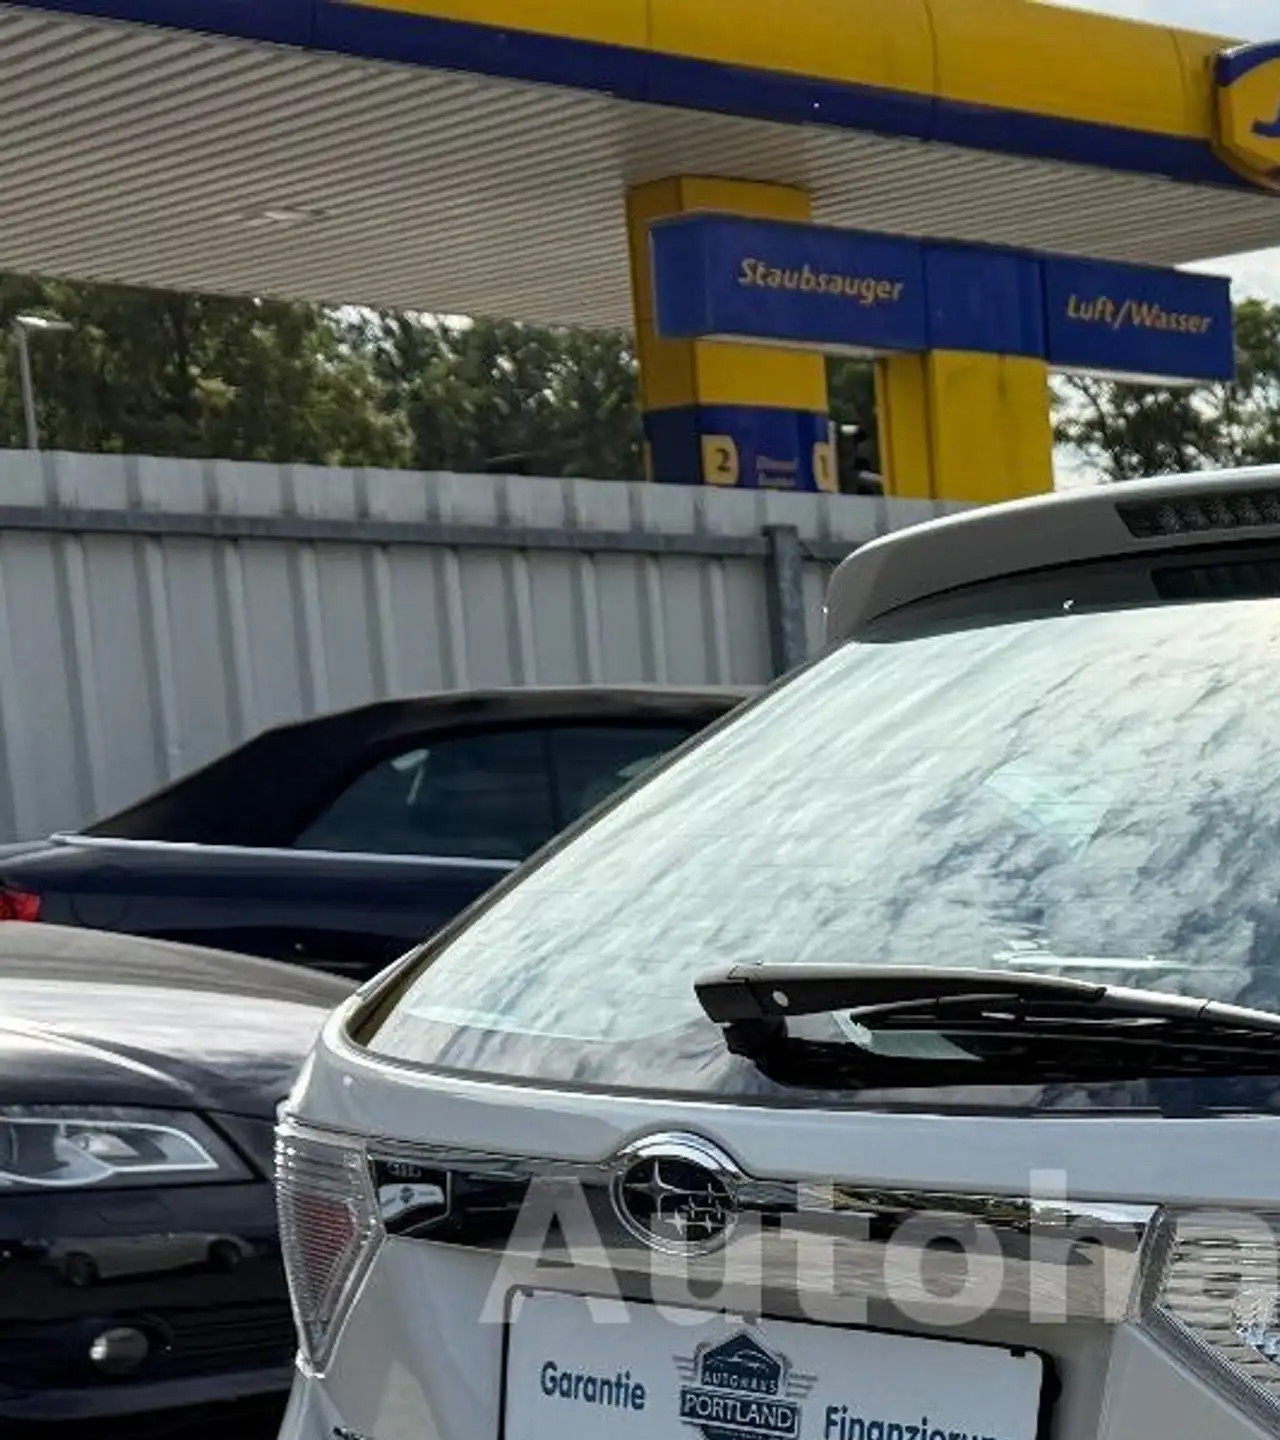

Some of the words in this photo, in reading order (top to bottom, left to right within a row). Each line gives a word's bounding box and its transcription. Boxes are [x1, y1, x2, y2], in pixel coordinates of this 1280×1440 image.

[738, 257, 904, 306] Staubsauger
[1066, 293, 1213, 334] Luft/Wasser
[715, 447, 731, 473] 2
[540, 1360, 647, 1410] Garantie
[683, 1393, 793, 1428] PORTLAND
